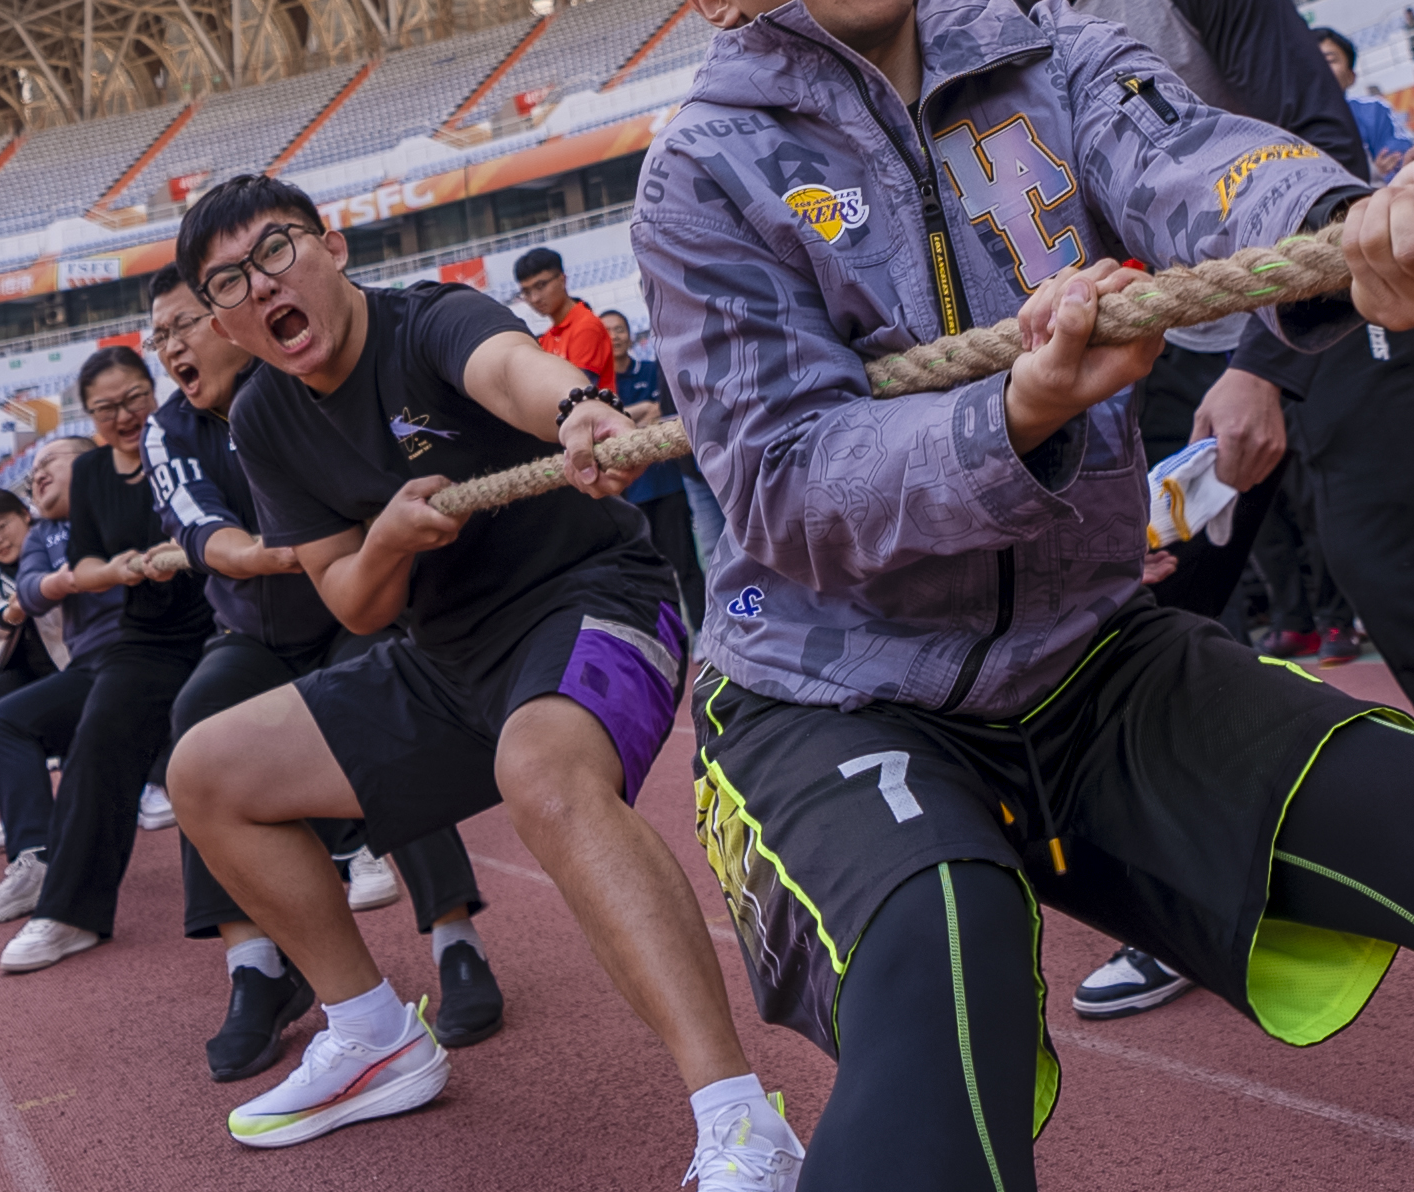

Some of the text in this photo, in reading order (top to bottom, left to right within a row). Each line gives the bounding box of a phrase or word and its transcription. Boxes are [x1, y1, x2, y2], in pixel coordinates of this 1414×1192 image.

[643, 156, 671, 205] OF
[318, 181, 435, 231] TSFC
[801, 199, 867, 225] KERS
[150, 458, 204, 508] 1911
[837, 750, 924, 824] 7
